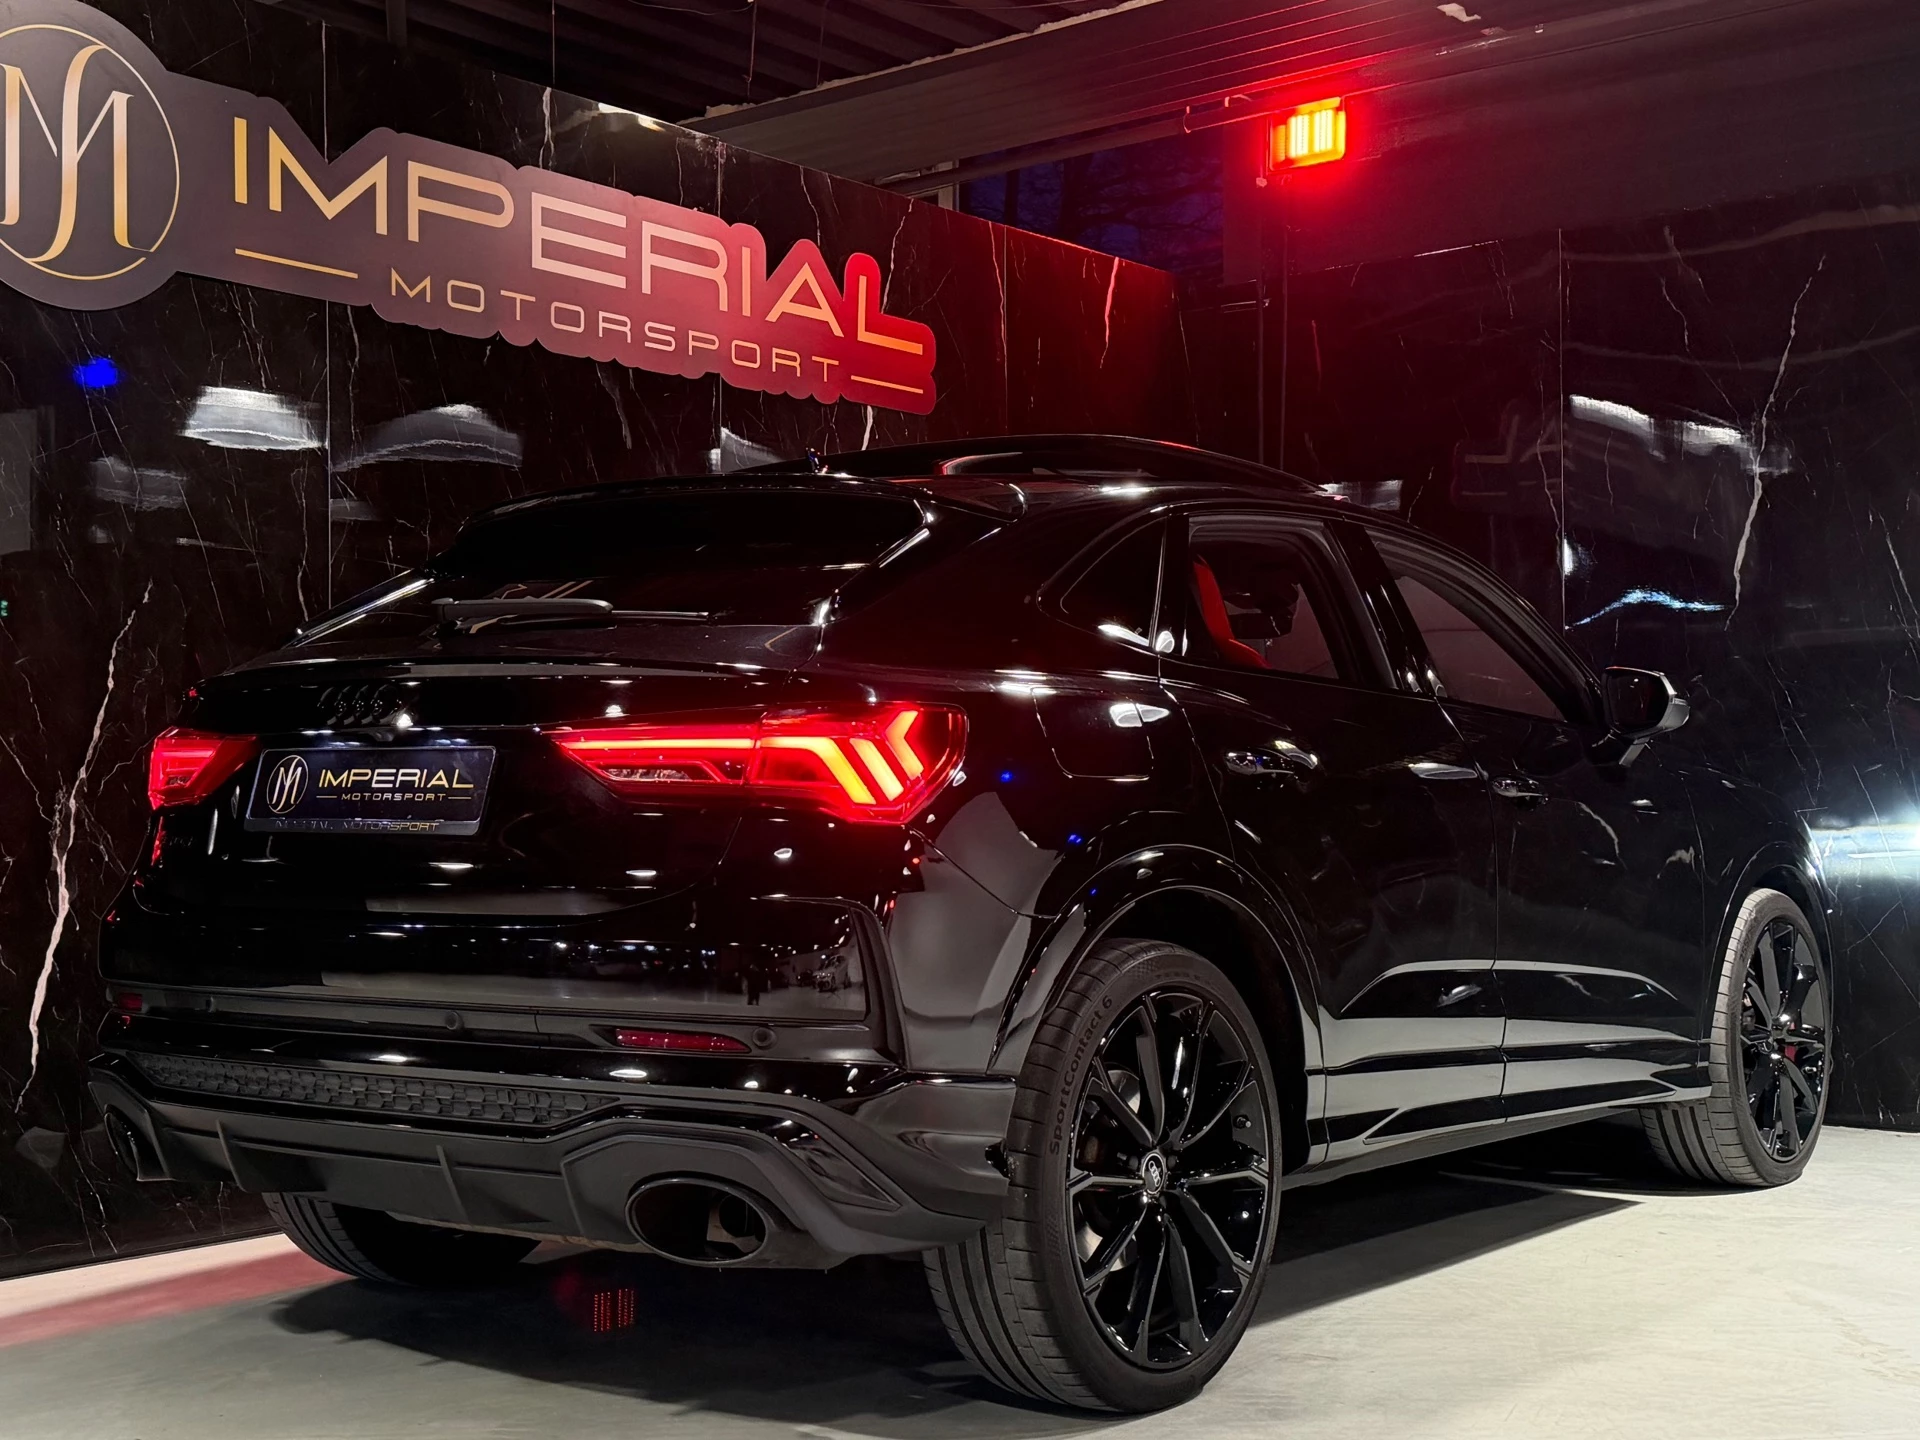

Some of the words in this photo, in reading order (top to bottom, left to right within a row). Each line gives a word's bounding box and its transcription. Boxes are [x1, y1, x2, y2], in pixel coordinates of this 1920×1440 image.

[235, 117, 924, 356] IMPERIAL
[391, 267, 840, 382] MOTORSPORT
[319, 769, 474, 788] IMPERIAL
[341, 793, 446, 801] MOTORSPORT
[1051, 1012, 1103, 1155] SportContact
[1102, 995, 1113, 1010] 6
